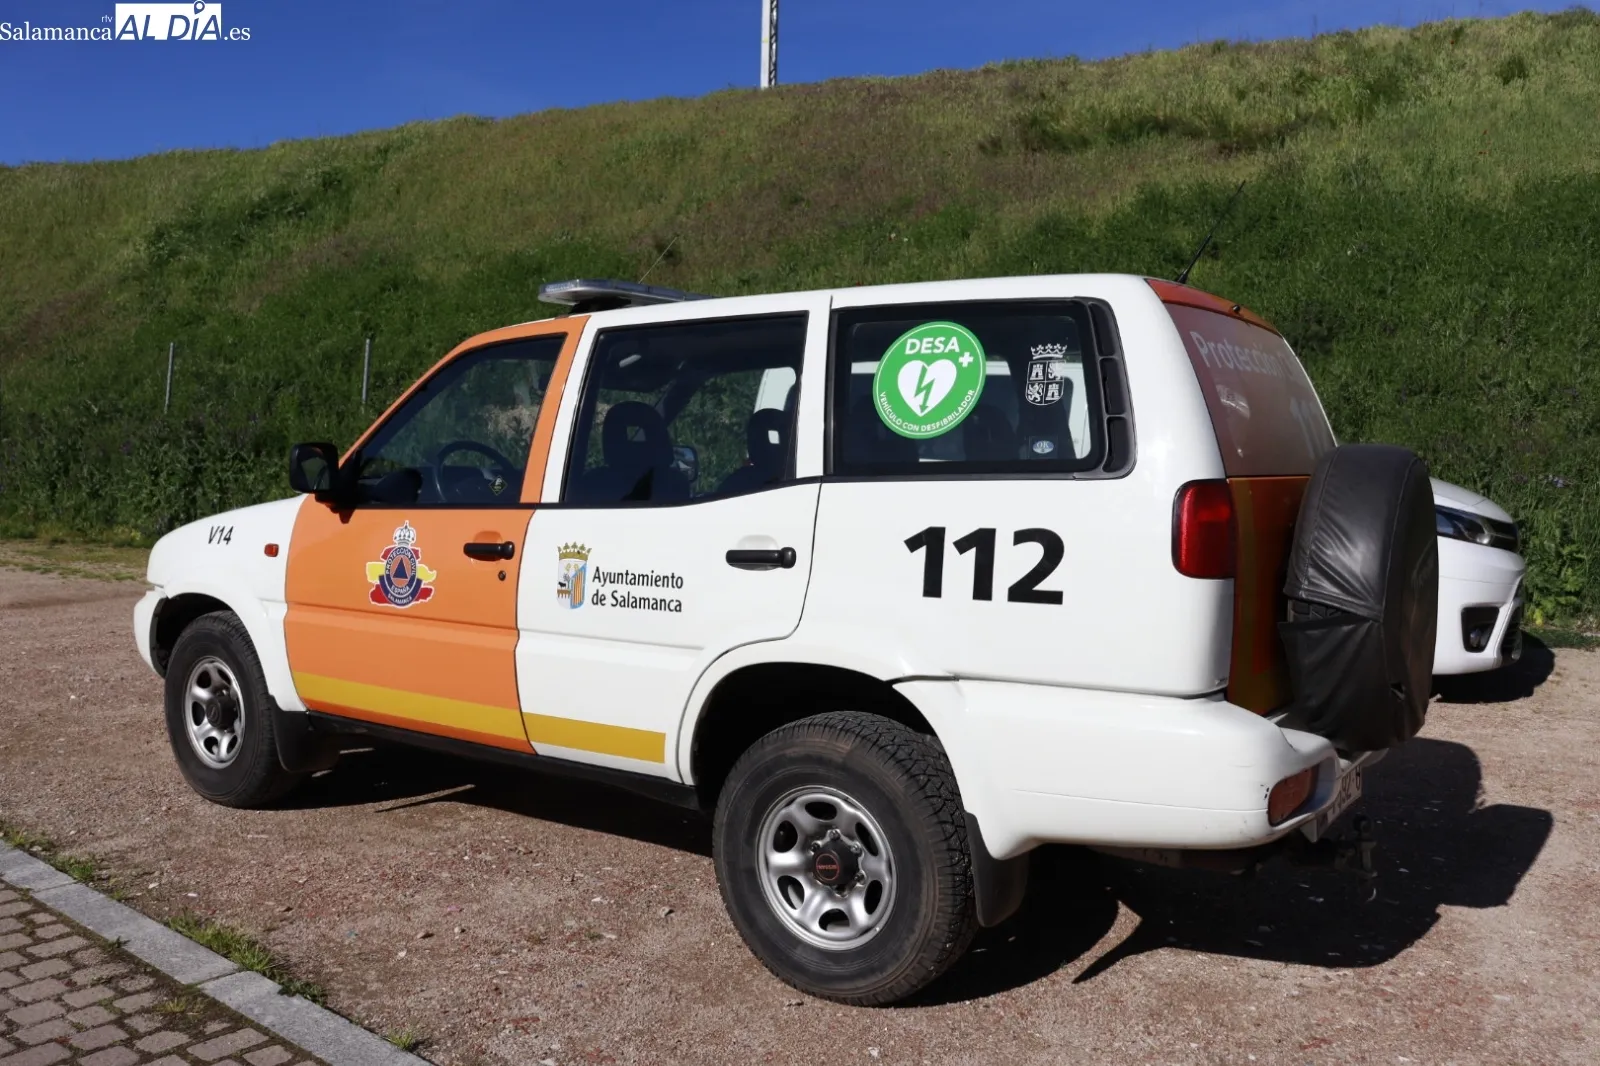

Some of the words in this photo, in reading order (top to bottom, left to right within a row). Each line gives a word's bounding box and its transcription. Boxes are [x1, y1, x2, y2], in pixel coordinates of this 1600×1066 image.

[905, 336, 960, 354] DESA
[880, 391, 902, 425] VEHÍCULO
[902, 422, 919, 431] CON
[921, 389, 975, 431] DESFIBRILADOR
[208, 526, 234, 545] V14
[903, 526, 1065, 605] 112
[592, 566, 684, 589] Ayuntamiento
[591, 589, 607, 606] de
[610, 590, 682, 613] Salamanca
